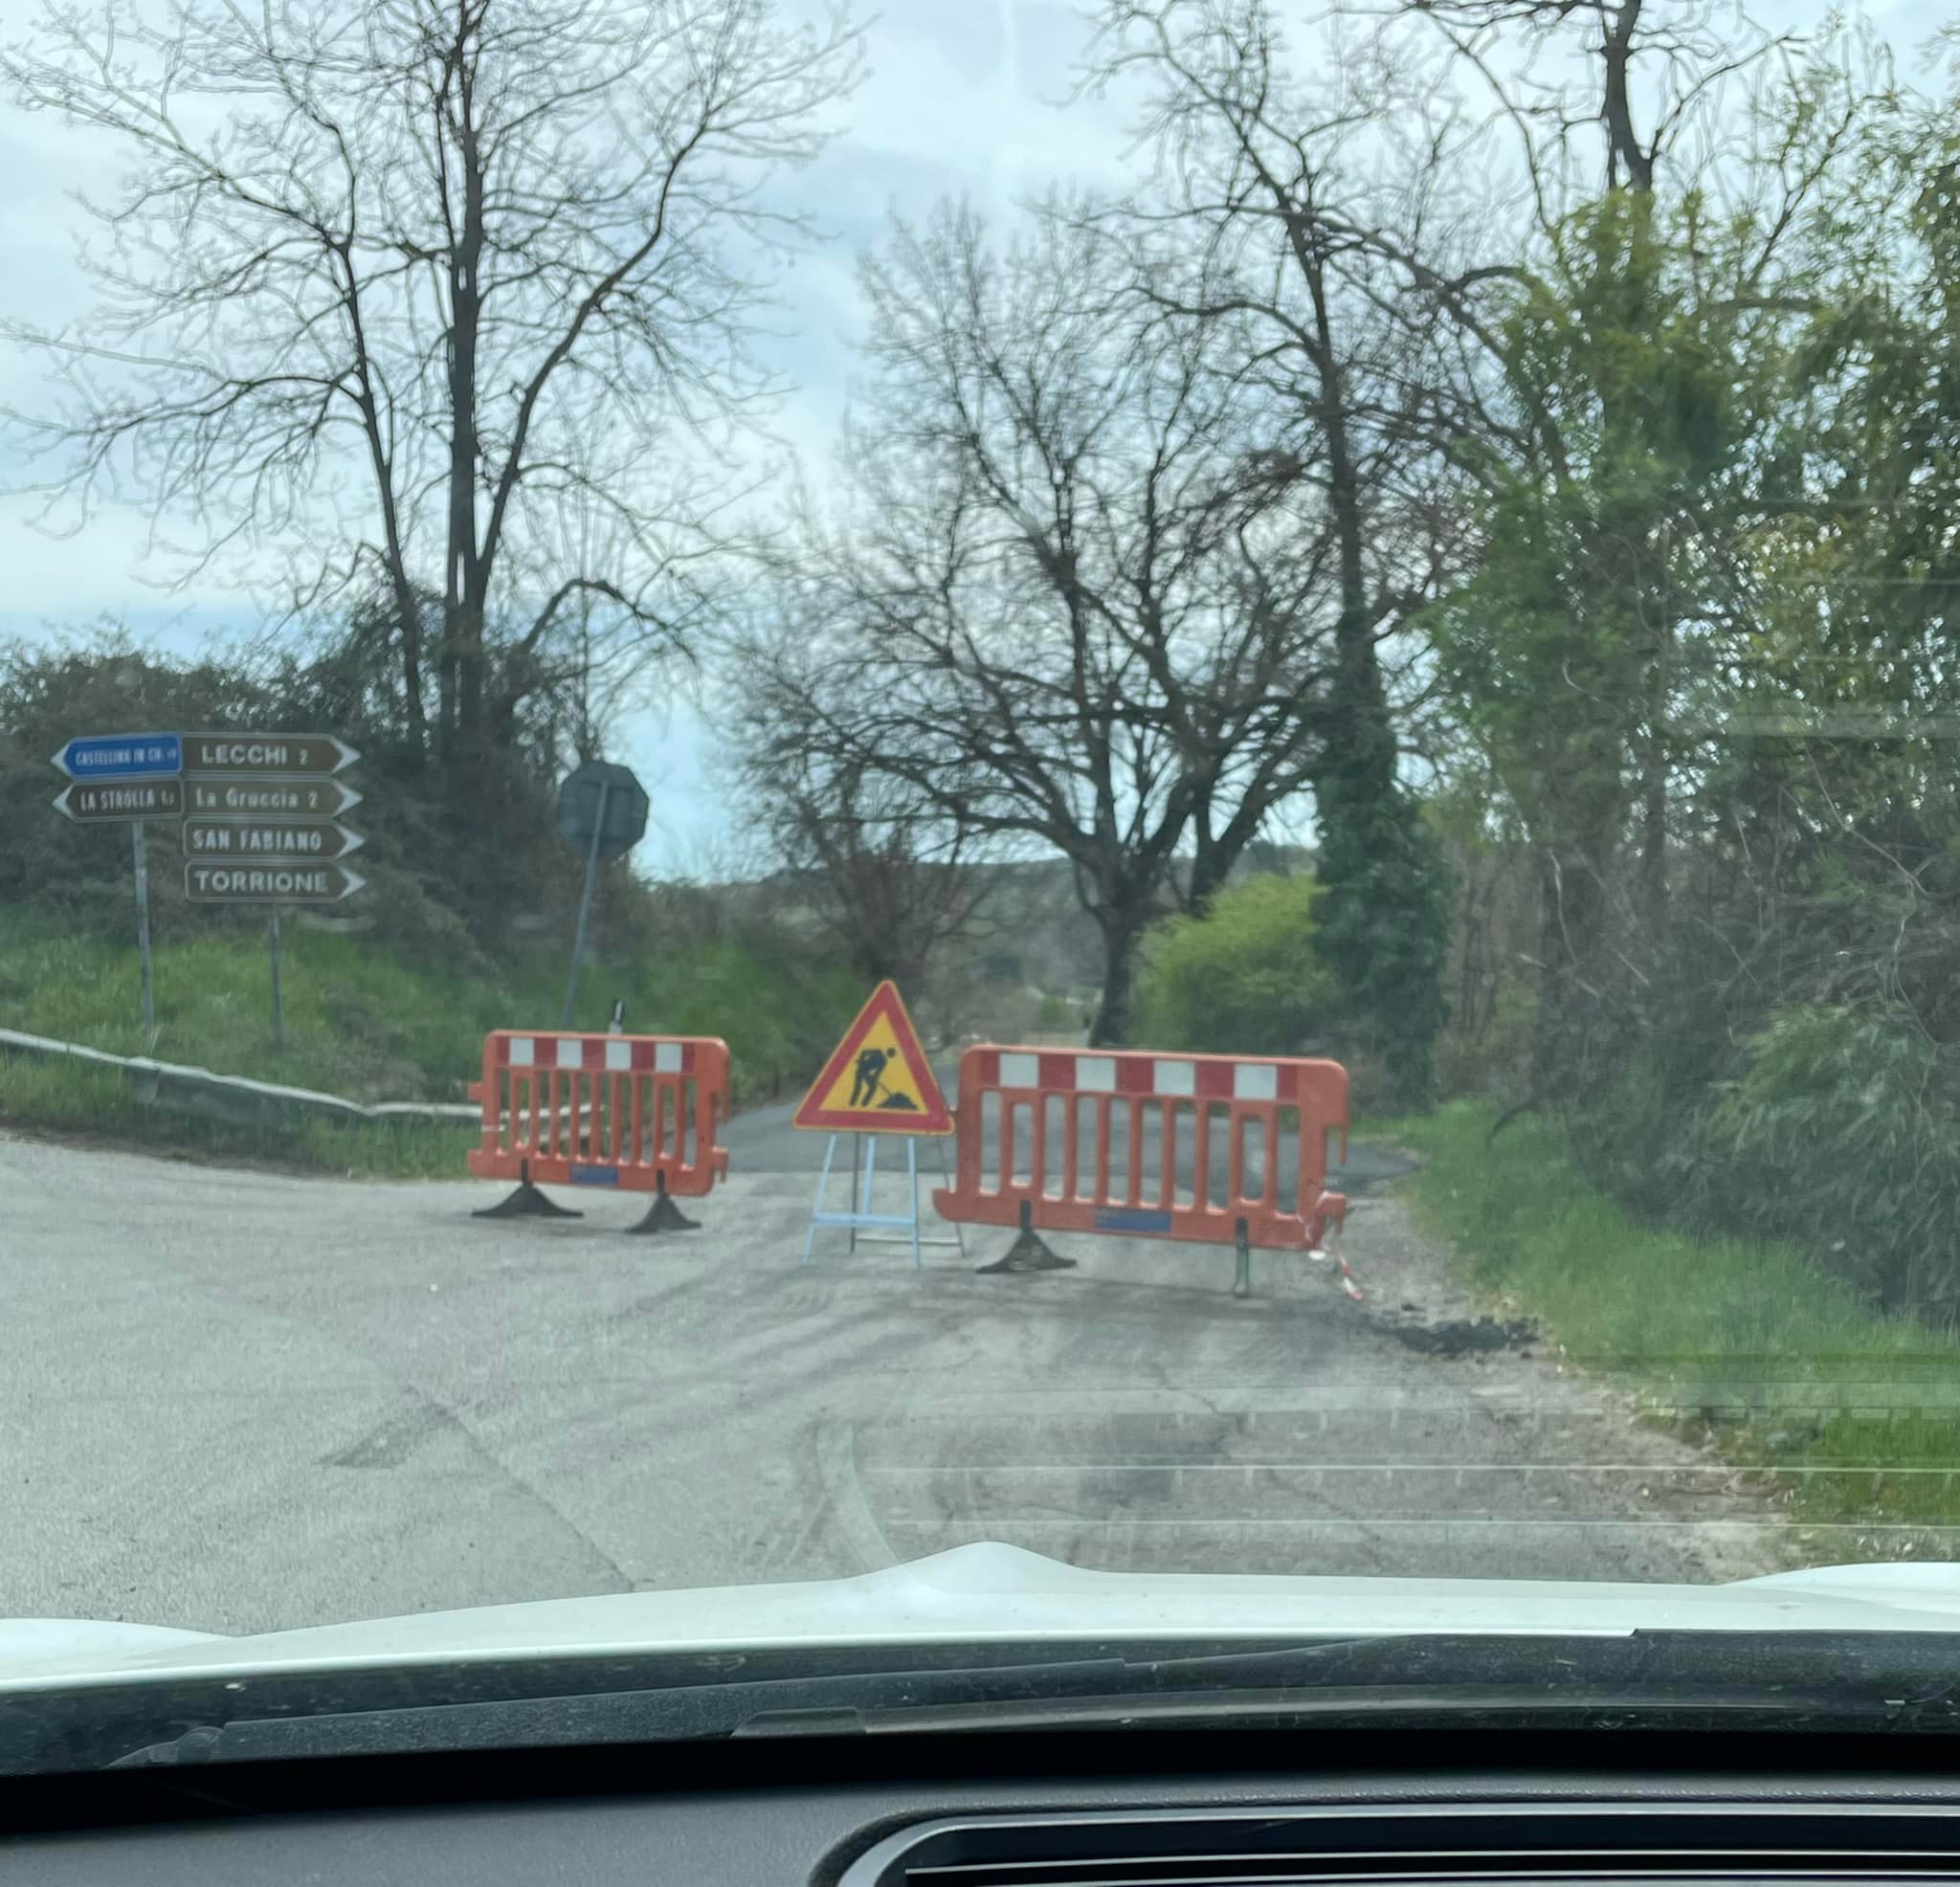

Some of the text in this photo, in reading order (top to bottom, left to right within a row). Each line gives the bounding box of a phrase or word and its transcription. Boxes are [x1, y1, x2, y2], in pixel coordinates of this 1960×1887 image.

[201, 744, 309, 766] LECCHI 2
[80, 791, 96, 811] LA
[196, 786, 217, 808] La
[308, 790, 319, 810] 2
[192, 829, 323, 852] SAN FABIANO
[194, 870, 329, 894] TORRIONE
